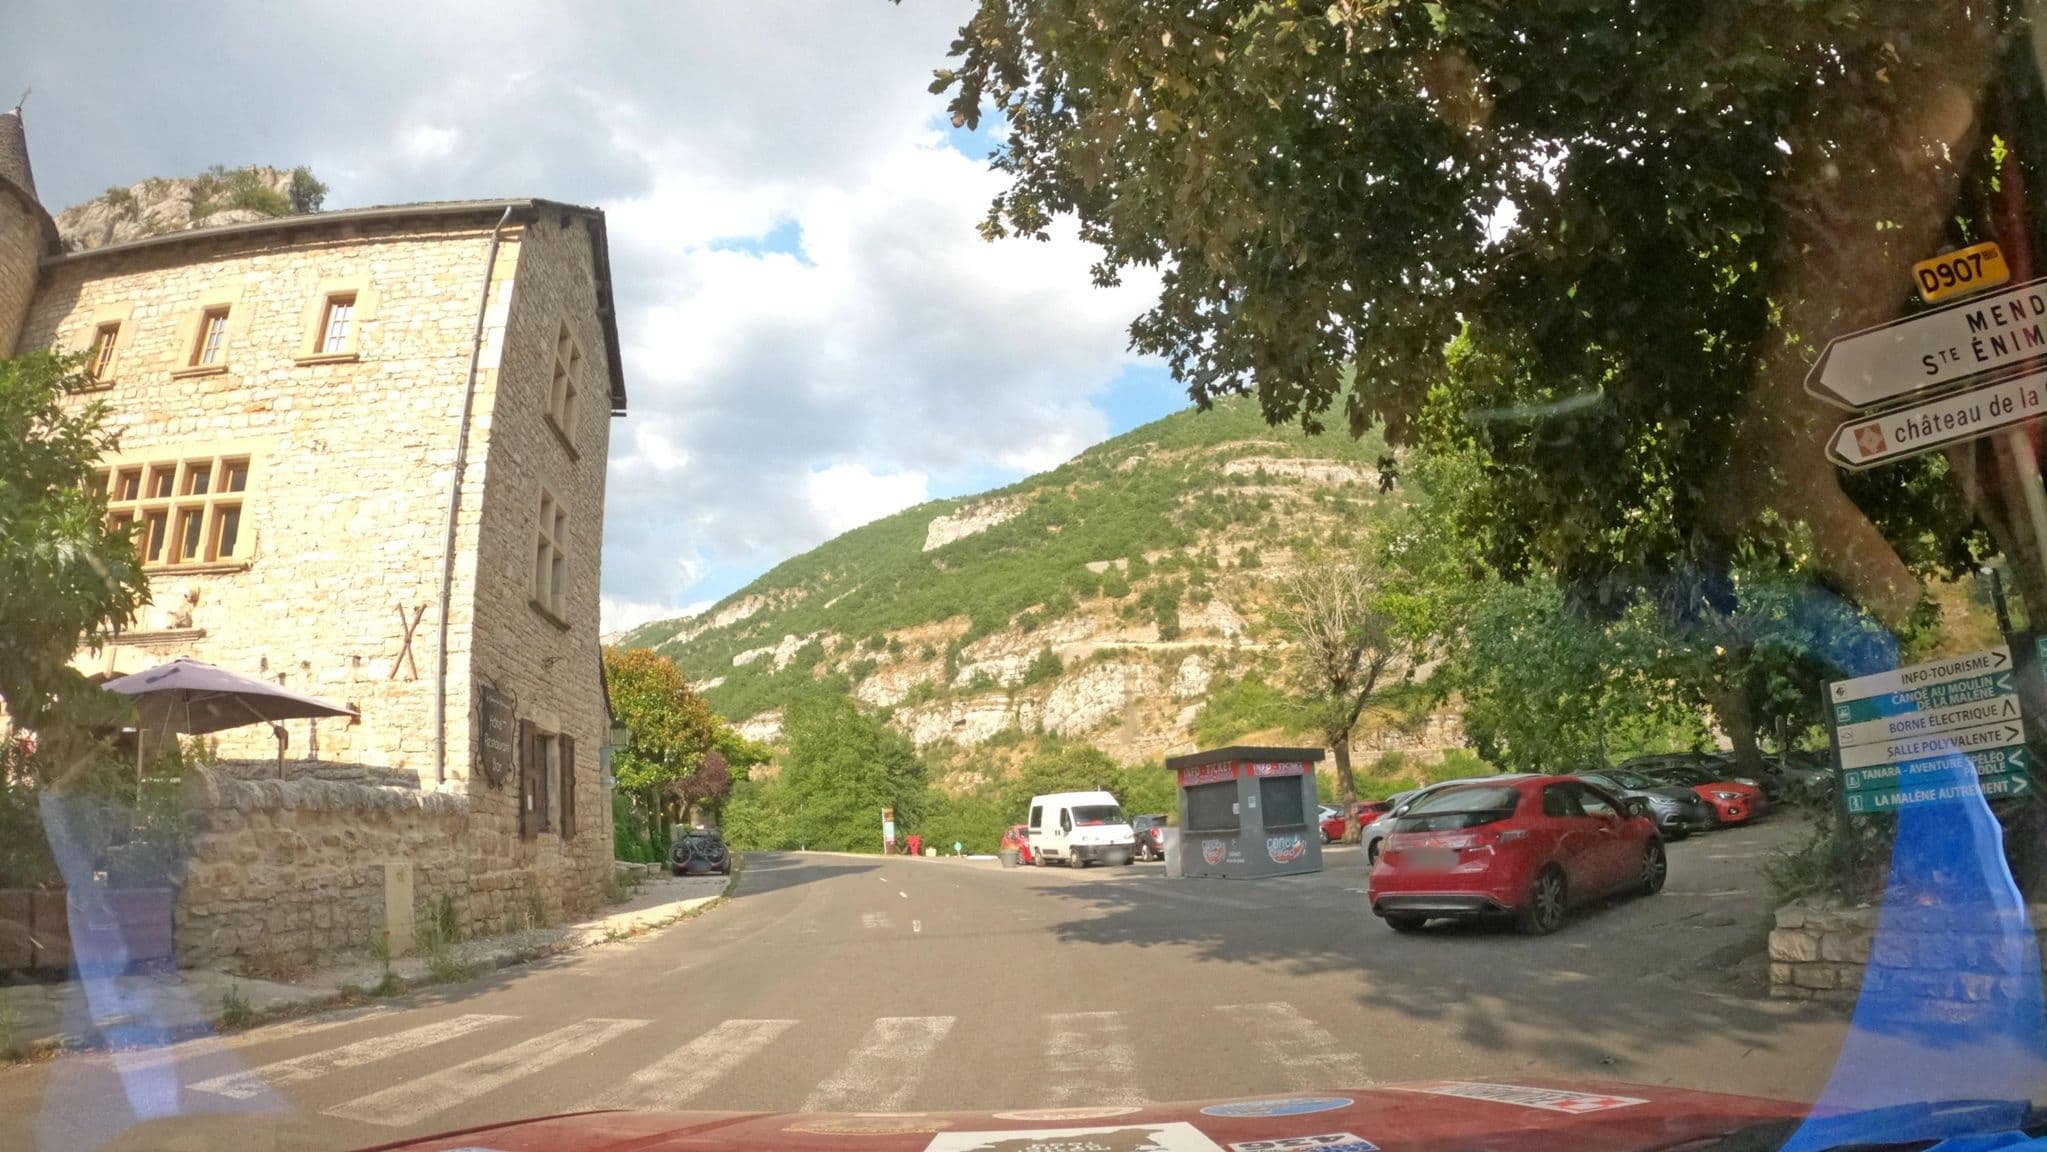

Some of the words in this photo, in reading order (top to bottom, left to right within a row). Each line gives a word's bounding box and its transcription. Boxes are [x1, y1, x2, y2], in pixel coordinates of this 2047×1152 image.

[1918, 253, 1983, 293] D907
[1895, 405, 1981, 443] château
[1989, 394, 2014, 417] de
[2019, 387, 2039, 408] la
[1901, 656, 1990, 685] INFO-TOURISME
[1930, 686, 1945, 698] AU
[1947, 676, 1993, 694] MOULIN
[1916, 700, 1931, 711] DE
[1932, 697, 1948, 707] LA
[1889, 718, 1927, 733] BORNE
[1929, 704, 1998, 727] ÉLECTRIQUE
[1887, 741, 1919, 759] SALLE
[1922, 730, 2002, 753] POLYVALENTE
[1184, 766, 1200, 778] INFO
[1206, 760, 1232, 776] TICKET
[1862, 767, 1901, 780] TANARA
[1909, 759, 1963, 775] AVENTURE
[1874, 794, 1889, 807] LA
[1939, 780, 2009, 799] AUTREMENT
